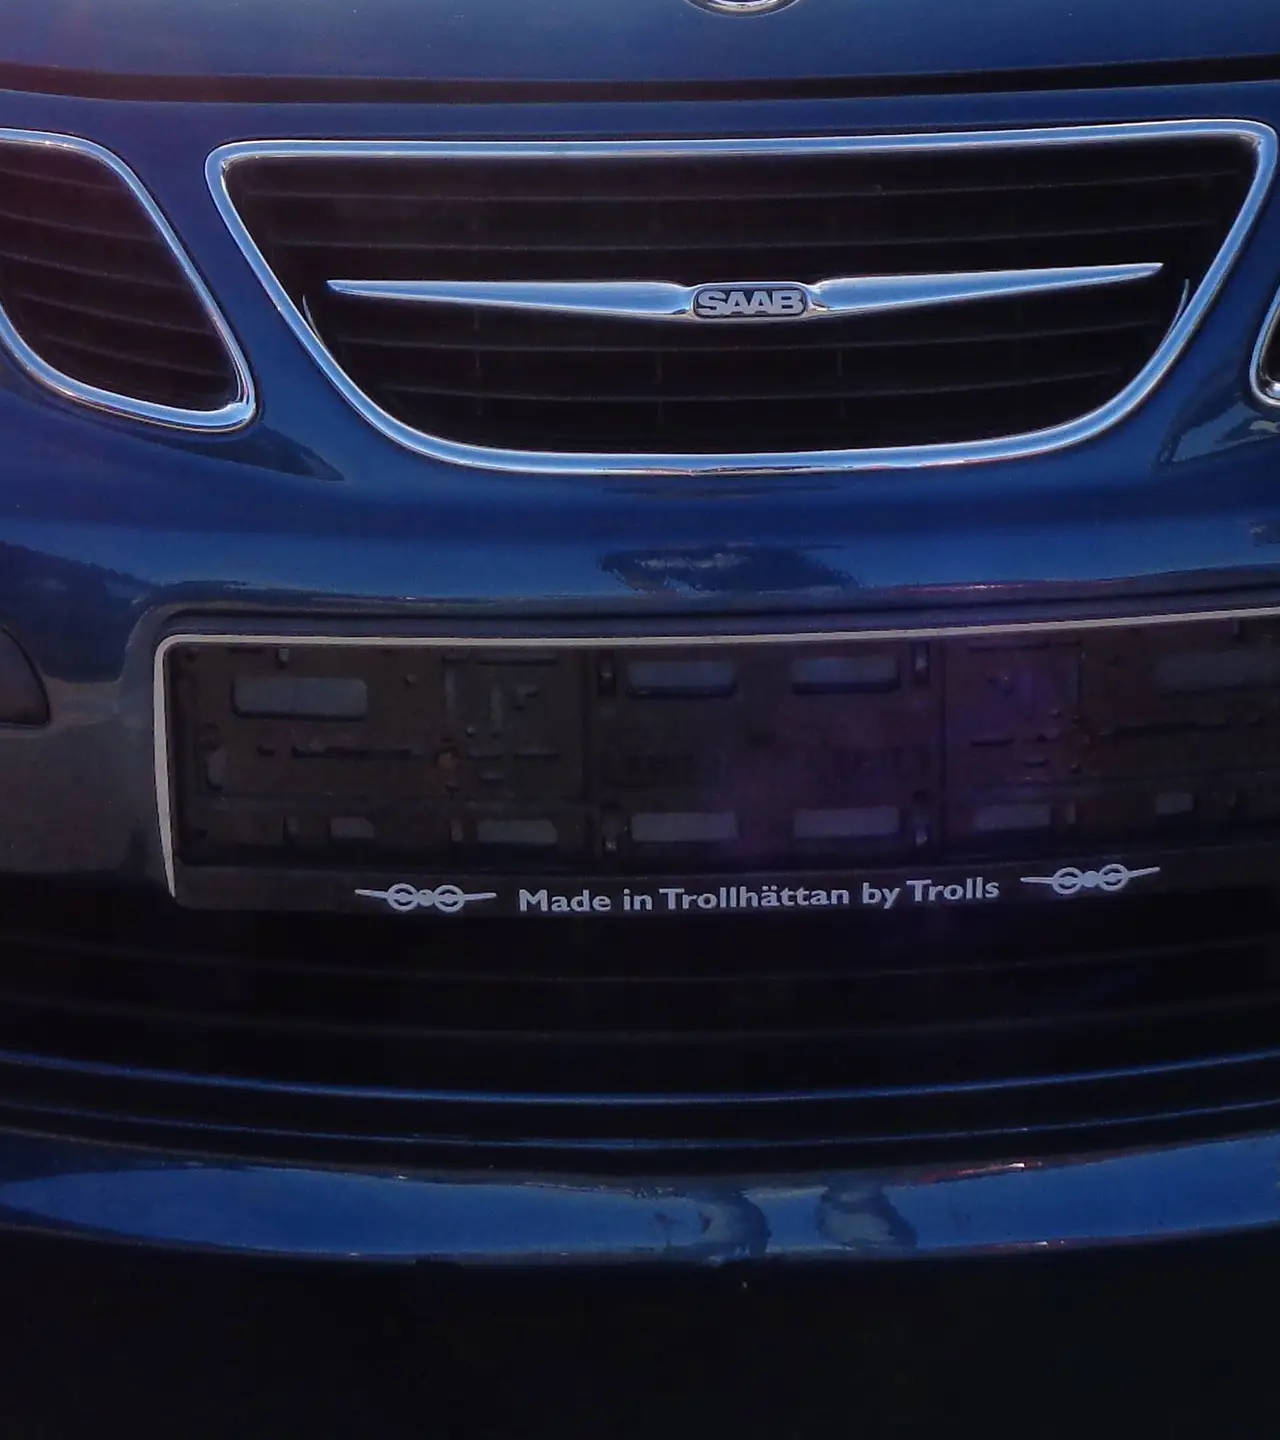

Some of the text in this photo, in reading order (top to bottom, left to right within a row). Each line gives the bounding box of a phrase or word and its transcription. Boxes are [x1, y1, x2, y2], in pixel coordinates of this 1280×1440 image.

[697, 290, 804, 316] SAAB
[519, 877, 1000, 912] Made in Trollhättan by Trolls
